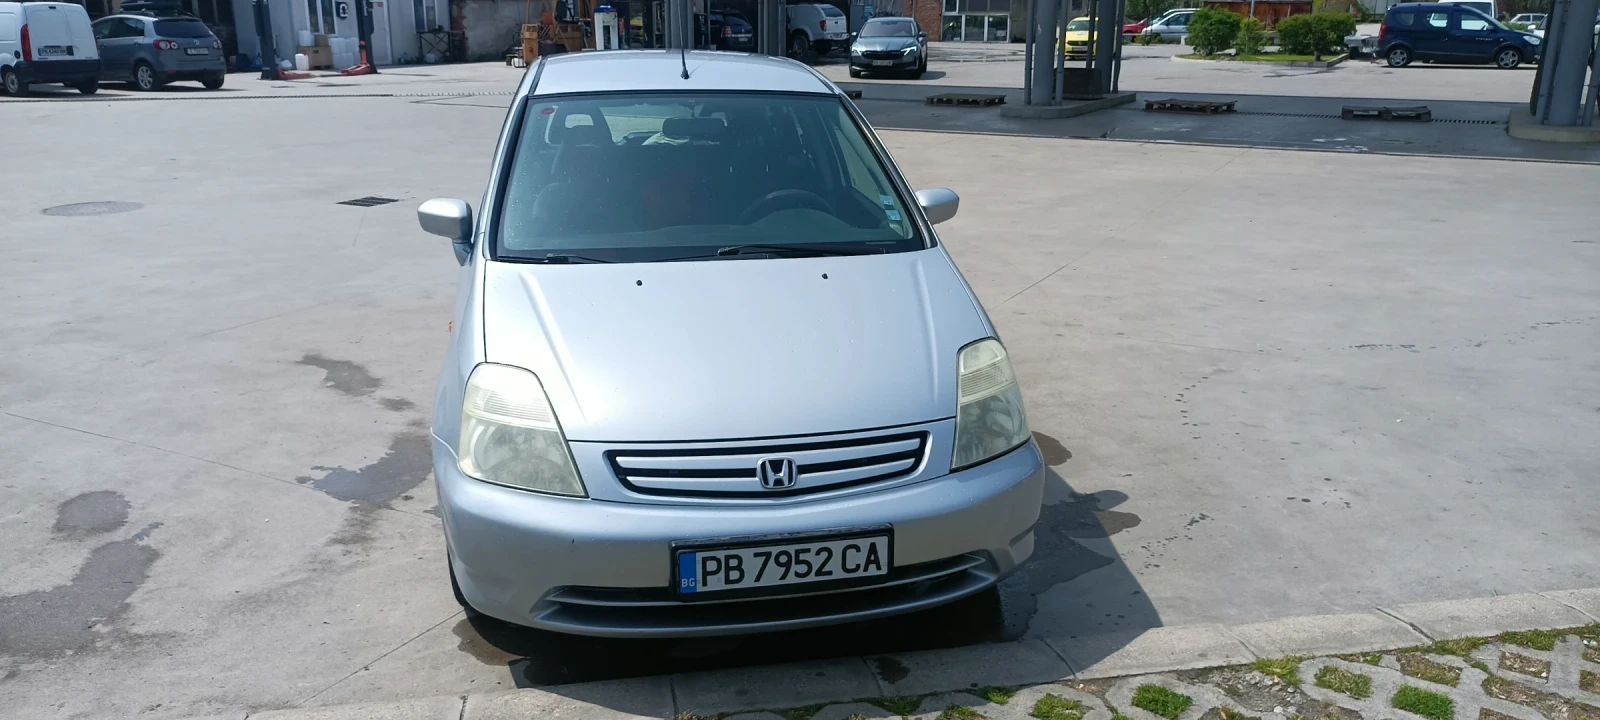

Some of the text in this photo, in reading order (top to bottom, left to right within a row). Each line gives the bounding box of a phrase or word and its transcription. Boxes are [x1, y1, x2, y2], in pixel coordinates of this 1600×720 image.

[701, 541, 882, 587] PB 7952 CA
[681, 578, 695, 588] BG
